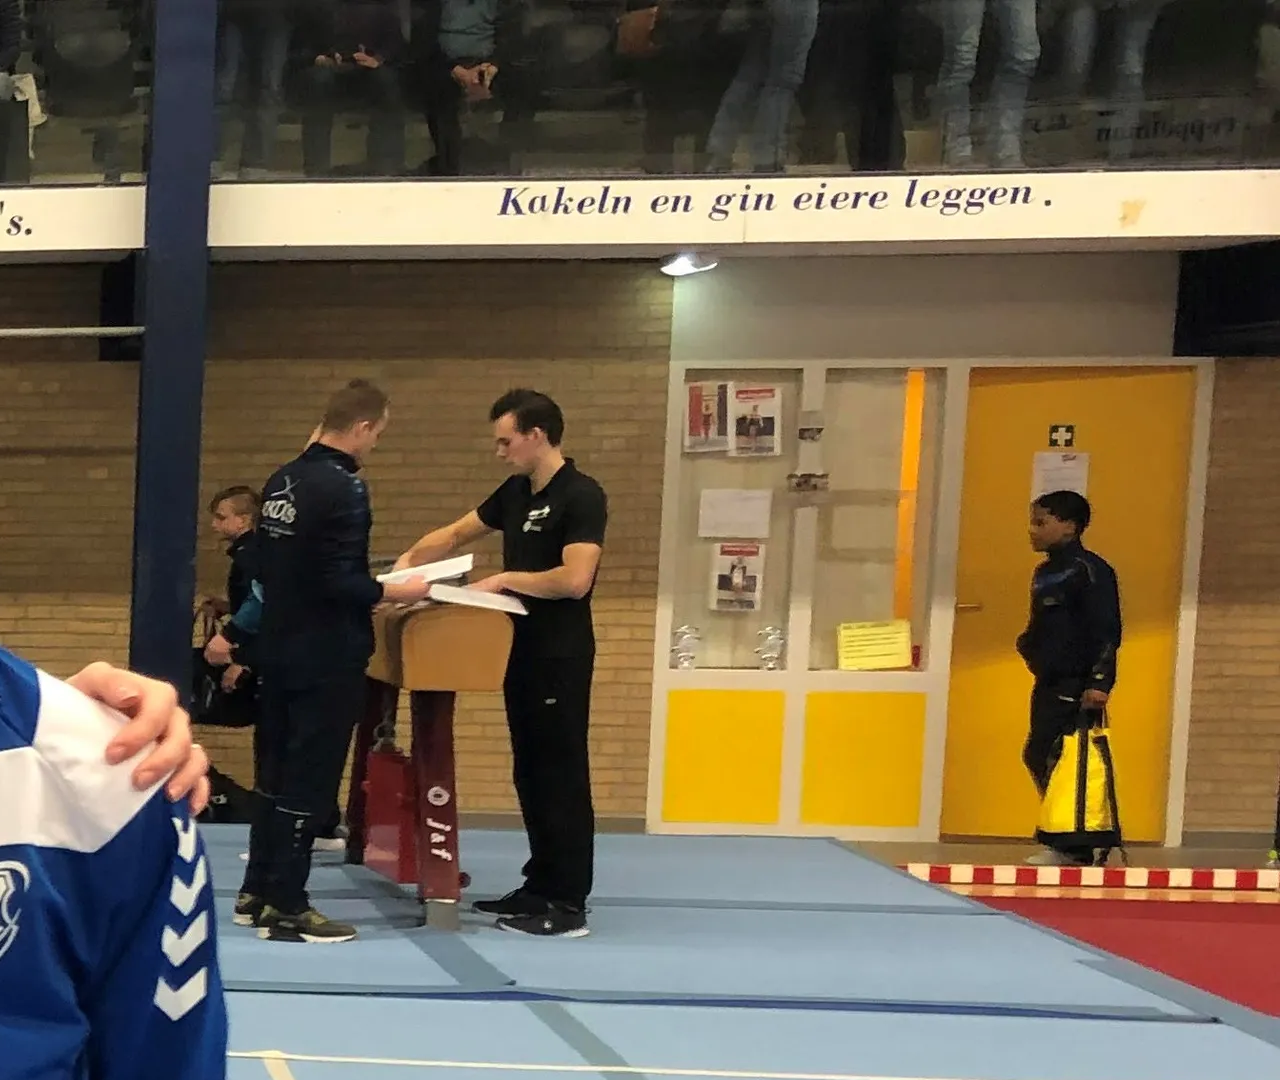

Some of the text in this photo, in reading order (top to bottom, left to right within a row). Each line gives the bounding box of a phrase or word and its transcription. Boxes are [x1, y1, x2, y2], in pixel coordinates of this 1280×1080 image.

[496, 185, 633, 216] Kakeln
[649, 193, 695, 214] en
[707, 184, 778, 222] gin
[792, 182, 889, 211] eiere
